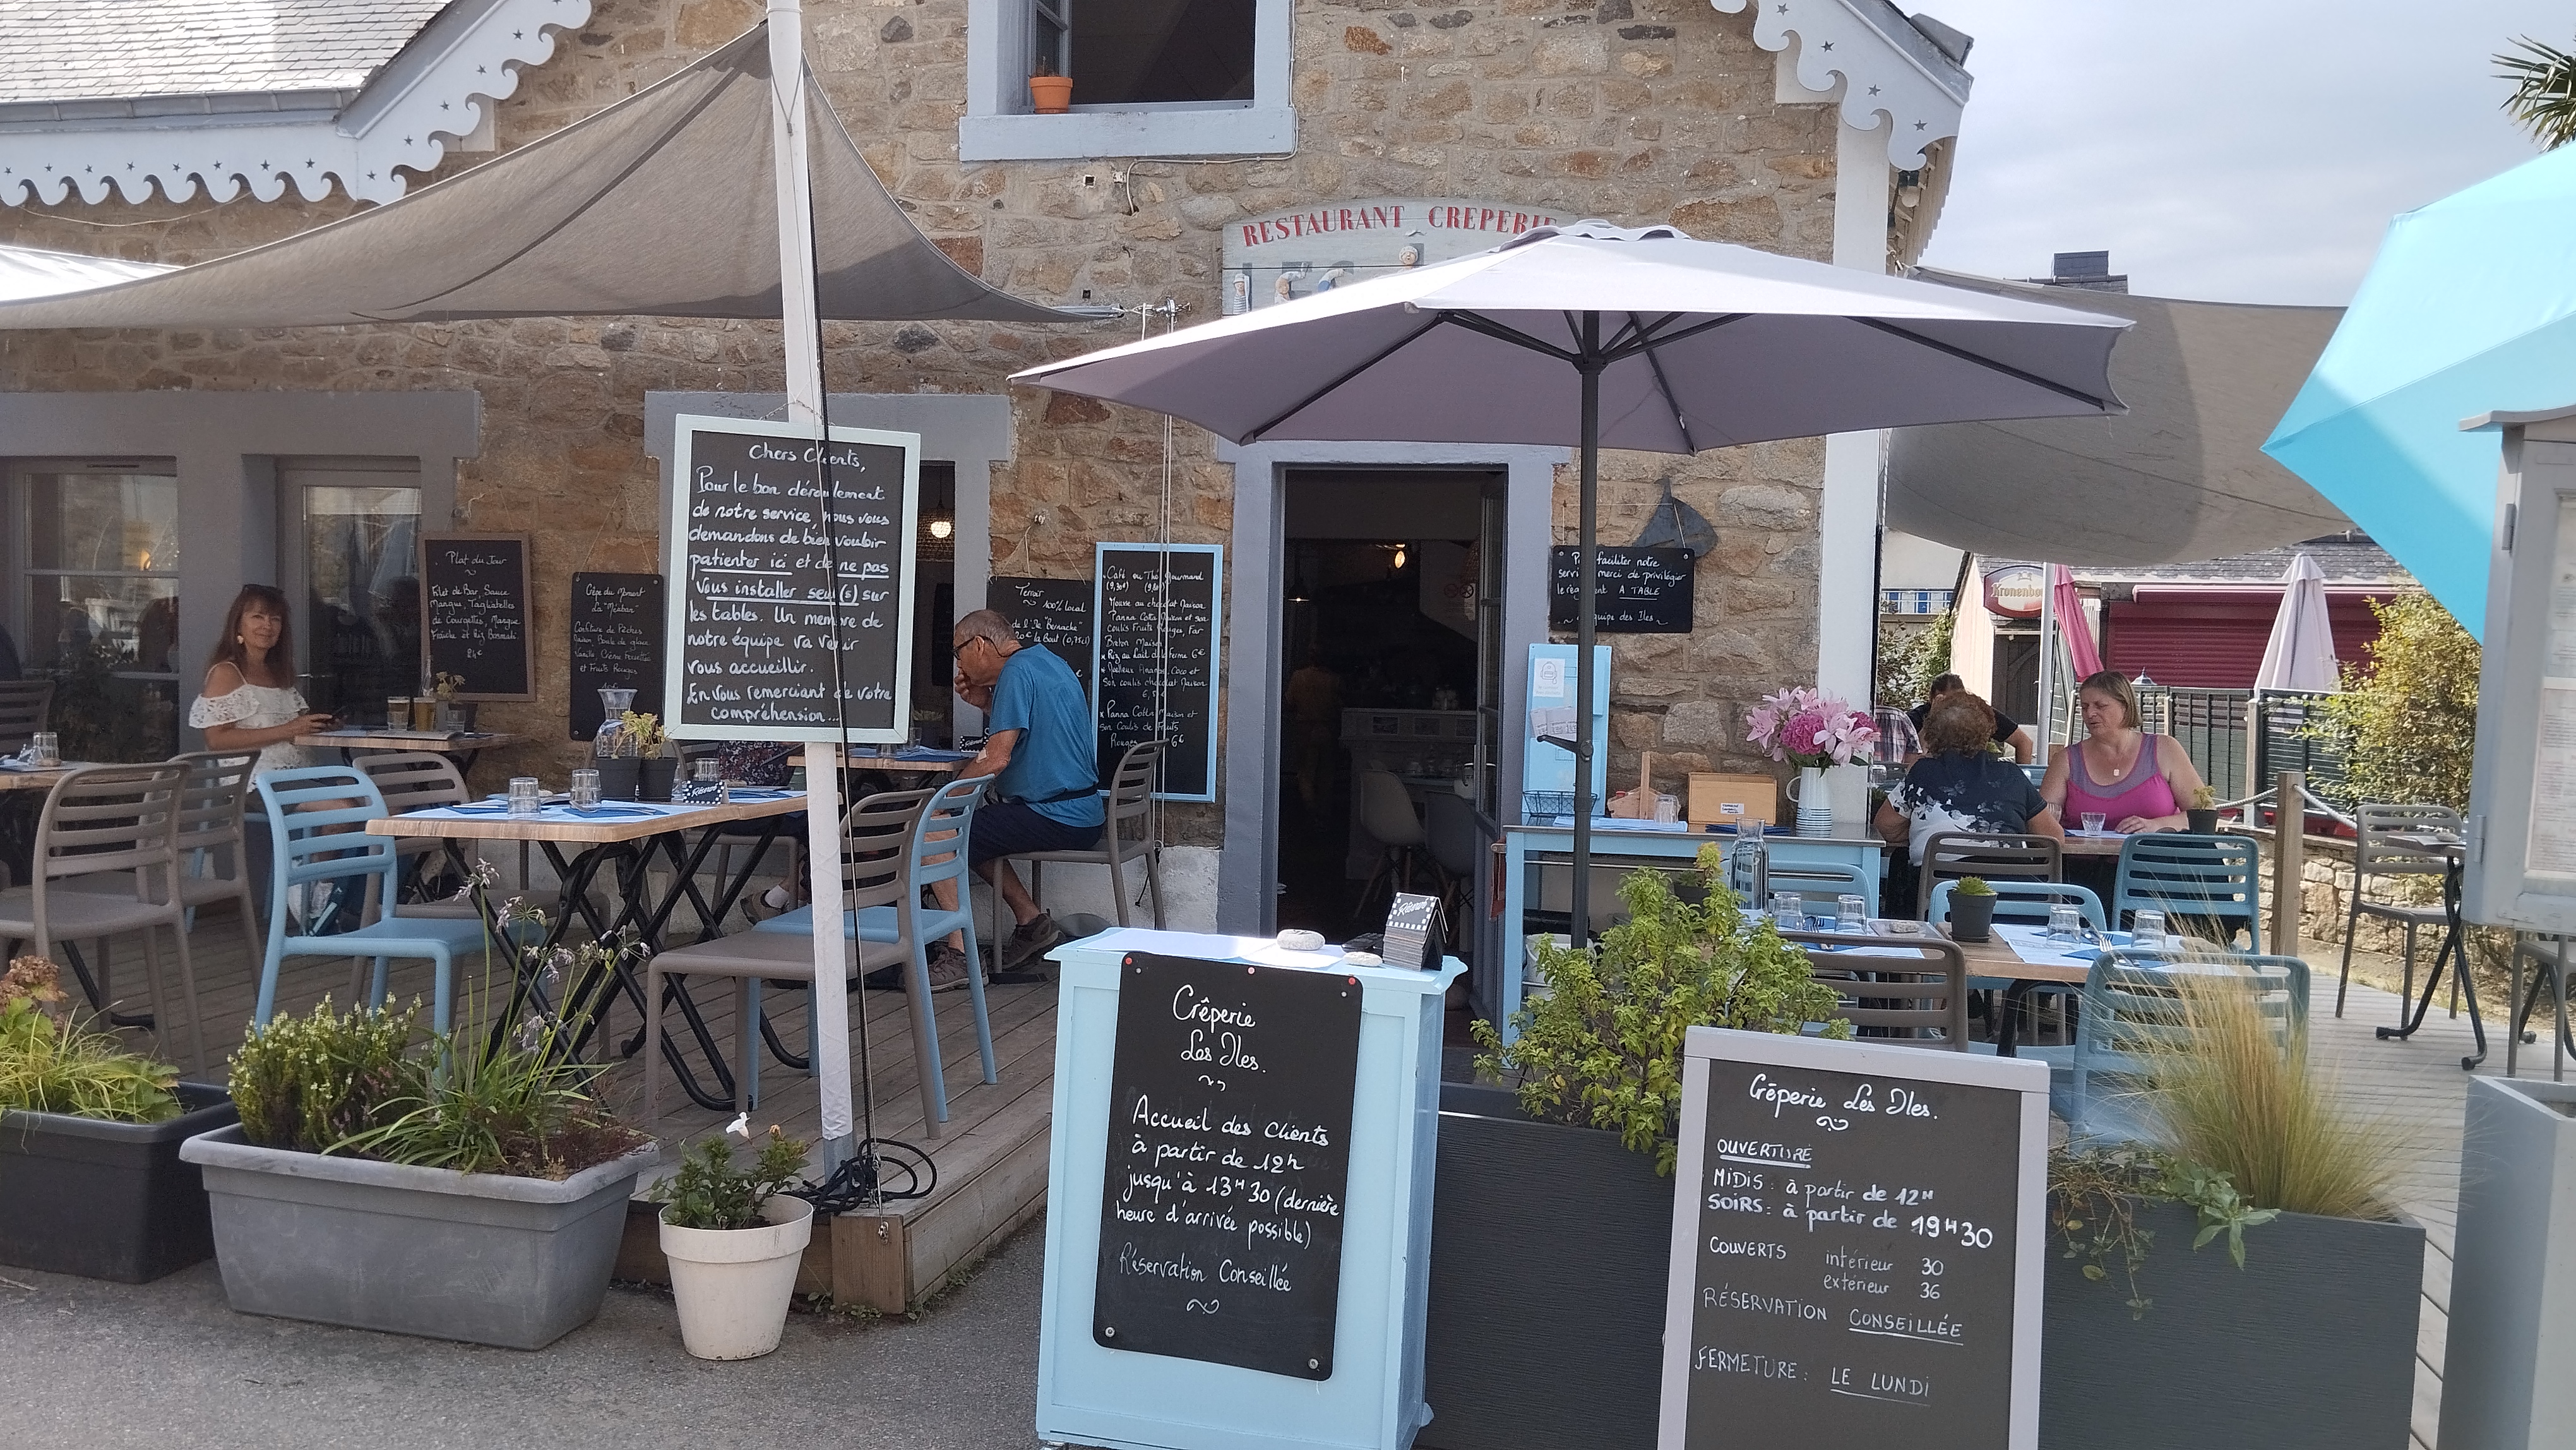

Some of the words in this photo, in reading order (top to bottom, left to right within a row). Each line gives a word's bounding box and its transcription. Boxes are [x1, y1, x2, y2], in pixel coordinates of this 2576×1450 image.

[1243, 205, 1405, 247] RESTAURANT
[749, 443, 796, 462] Chers
[696, 465, 729, 493] Pour
[733, 470, 749, 494] le
[753, 473, 781, 496] bon
[787, 480, 885, 500] déroulement
[693, 500, 710, 517] de
[715, 503, 758, 520] notre
[823, 511, 854, 525] nous
[858, 513, 890, 525] vous
[689, 522, 775, 543] demandons
[778, 528, 800, 545] de
[802, 528, 830, 548] bien
[446, 550, 469, 565] Plat
[472, 554, 484, 564] du
[486, 555, 508, 565] Jour
[689, 548, 760, 580] patienter
[770, 552, 787, 568] ici
[796, 553, 813, 568] et
[814, 553, 833, 569] de
[839, 560, 857, 573] ne
[861, 560, 889, 580] pas
[1596, 551, 1631, 565] faciliter
[1637, 556, 1660, 568] notre
[1107, 566, 1126, 580] Café
[1598, 569, 1622, 578] merci
[1628, 569, 1640, 578] de
[1642, 570, 1686, 587] privilégier
[452, 585, 462, 596] de
[484, 584, 510, 596] Sauce
[586, 583, 602, 602] Crêpe
[604, 587, 615, 596] du
[617, 587, 646, 602] Moment
[735, 580, 797, 599] installer
[862, 589, 889, 601] sur
[1015, 582, 1045, 597] Terroir
[1557, 583, 1565, 594] le
[1619, 585, 1625, 594] A
[1631, 586, 1661, 596] TABLE
[592, 602, 603, 613] La
[690, 599, 707, 623] les
[712, 602, 763, 623] tables.
[774, 606, 796, 625] Un
[805, 613, 857, 628] memre
[862, 611, 883, 628] de
[1042, 600, 1064, 611] 100%
[1065, 600, 1087, 613] local
[1108, 611, 1136, 621] Panna
[1619, 610, 1633, 621] des
[1638, 609, 1654, 621] Iles
[432, 616, 442, 625] de
[574, 621, 603, 633] Confiture
[606, 625, 616, 633] de
[1011, 618, 1022, 628] de
[617, 637, 627, 645] de
[688, 629, 728, 647] notre
[732, 627, 785, 658] équipe
[794, 635, 813, 649] va
[1034, 632, 1042, 642] la
[688, 661, 723, 674] vous
[729, 656, 814, 674] accueillir.
[1108, 649, 1120, 664] Riz
[686, 683, 710, 704] En
[747, 681, 826, 700] remerciant
[857, 681, 892, 700] votre
[1107, 700, 1130, 718] Panna
[1172, 984, 1256, 1033] Crêperie
[1181, 1029, 1212, 1061] Les
[1749, 1072, 1827, 1118] Crêperie
[1844, 1083, 1876, 1113] Les
[1133, 1094, 1212, 1131] Accueil
[1222, 1115, 1252, 1136] des
[1131, 1134, 1147, 1154] à
[1155, 1141, 1217, 1168] partir
[1222, 1147, 1248, 1168] de
[1253, 1153, 1305, 1173] 12h
[1717, 1138, 1813, 1163] OUVERTURE
[1123, 1165, 1197, 1203] jusqu'à
[1275, 1185, 1340, 1216] (dernière
[1786, 1179, 1798, 1195] à
[1804, 1180, 1855, 1208] partir
[1863, 1184, 1888, 1202] de
[1116, 1199, 1156, 1223] heure
[1166, 1200, 1237, 1231] d'arrivée
[1248, 1218, 1311, 1250] possible)
[1782, 1202, 1799, 1219] à
[1805, 1205, 1866, 1232] partir
[1873, 1209, 1898, 1230] de
[1119, 1242, 1207, 1283] Réservation
[1219, 1259, 1292, 1292] Conseillée
[1826, 1245, 1893, 1271] intérieur
[1921, 1257, 1943, 1276] 30
[1823, 1272, 1890, 1295] extérieur
[1919, 1281, 1941, 1300] 36
[1831, 1367, 1851, 1386] LE
